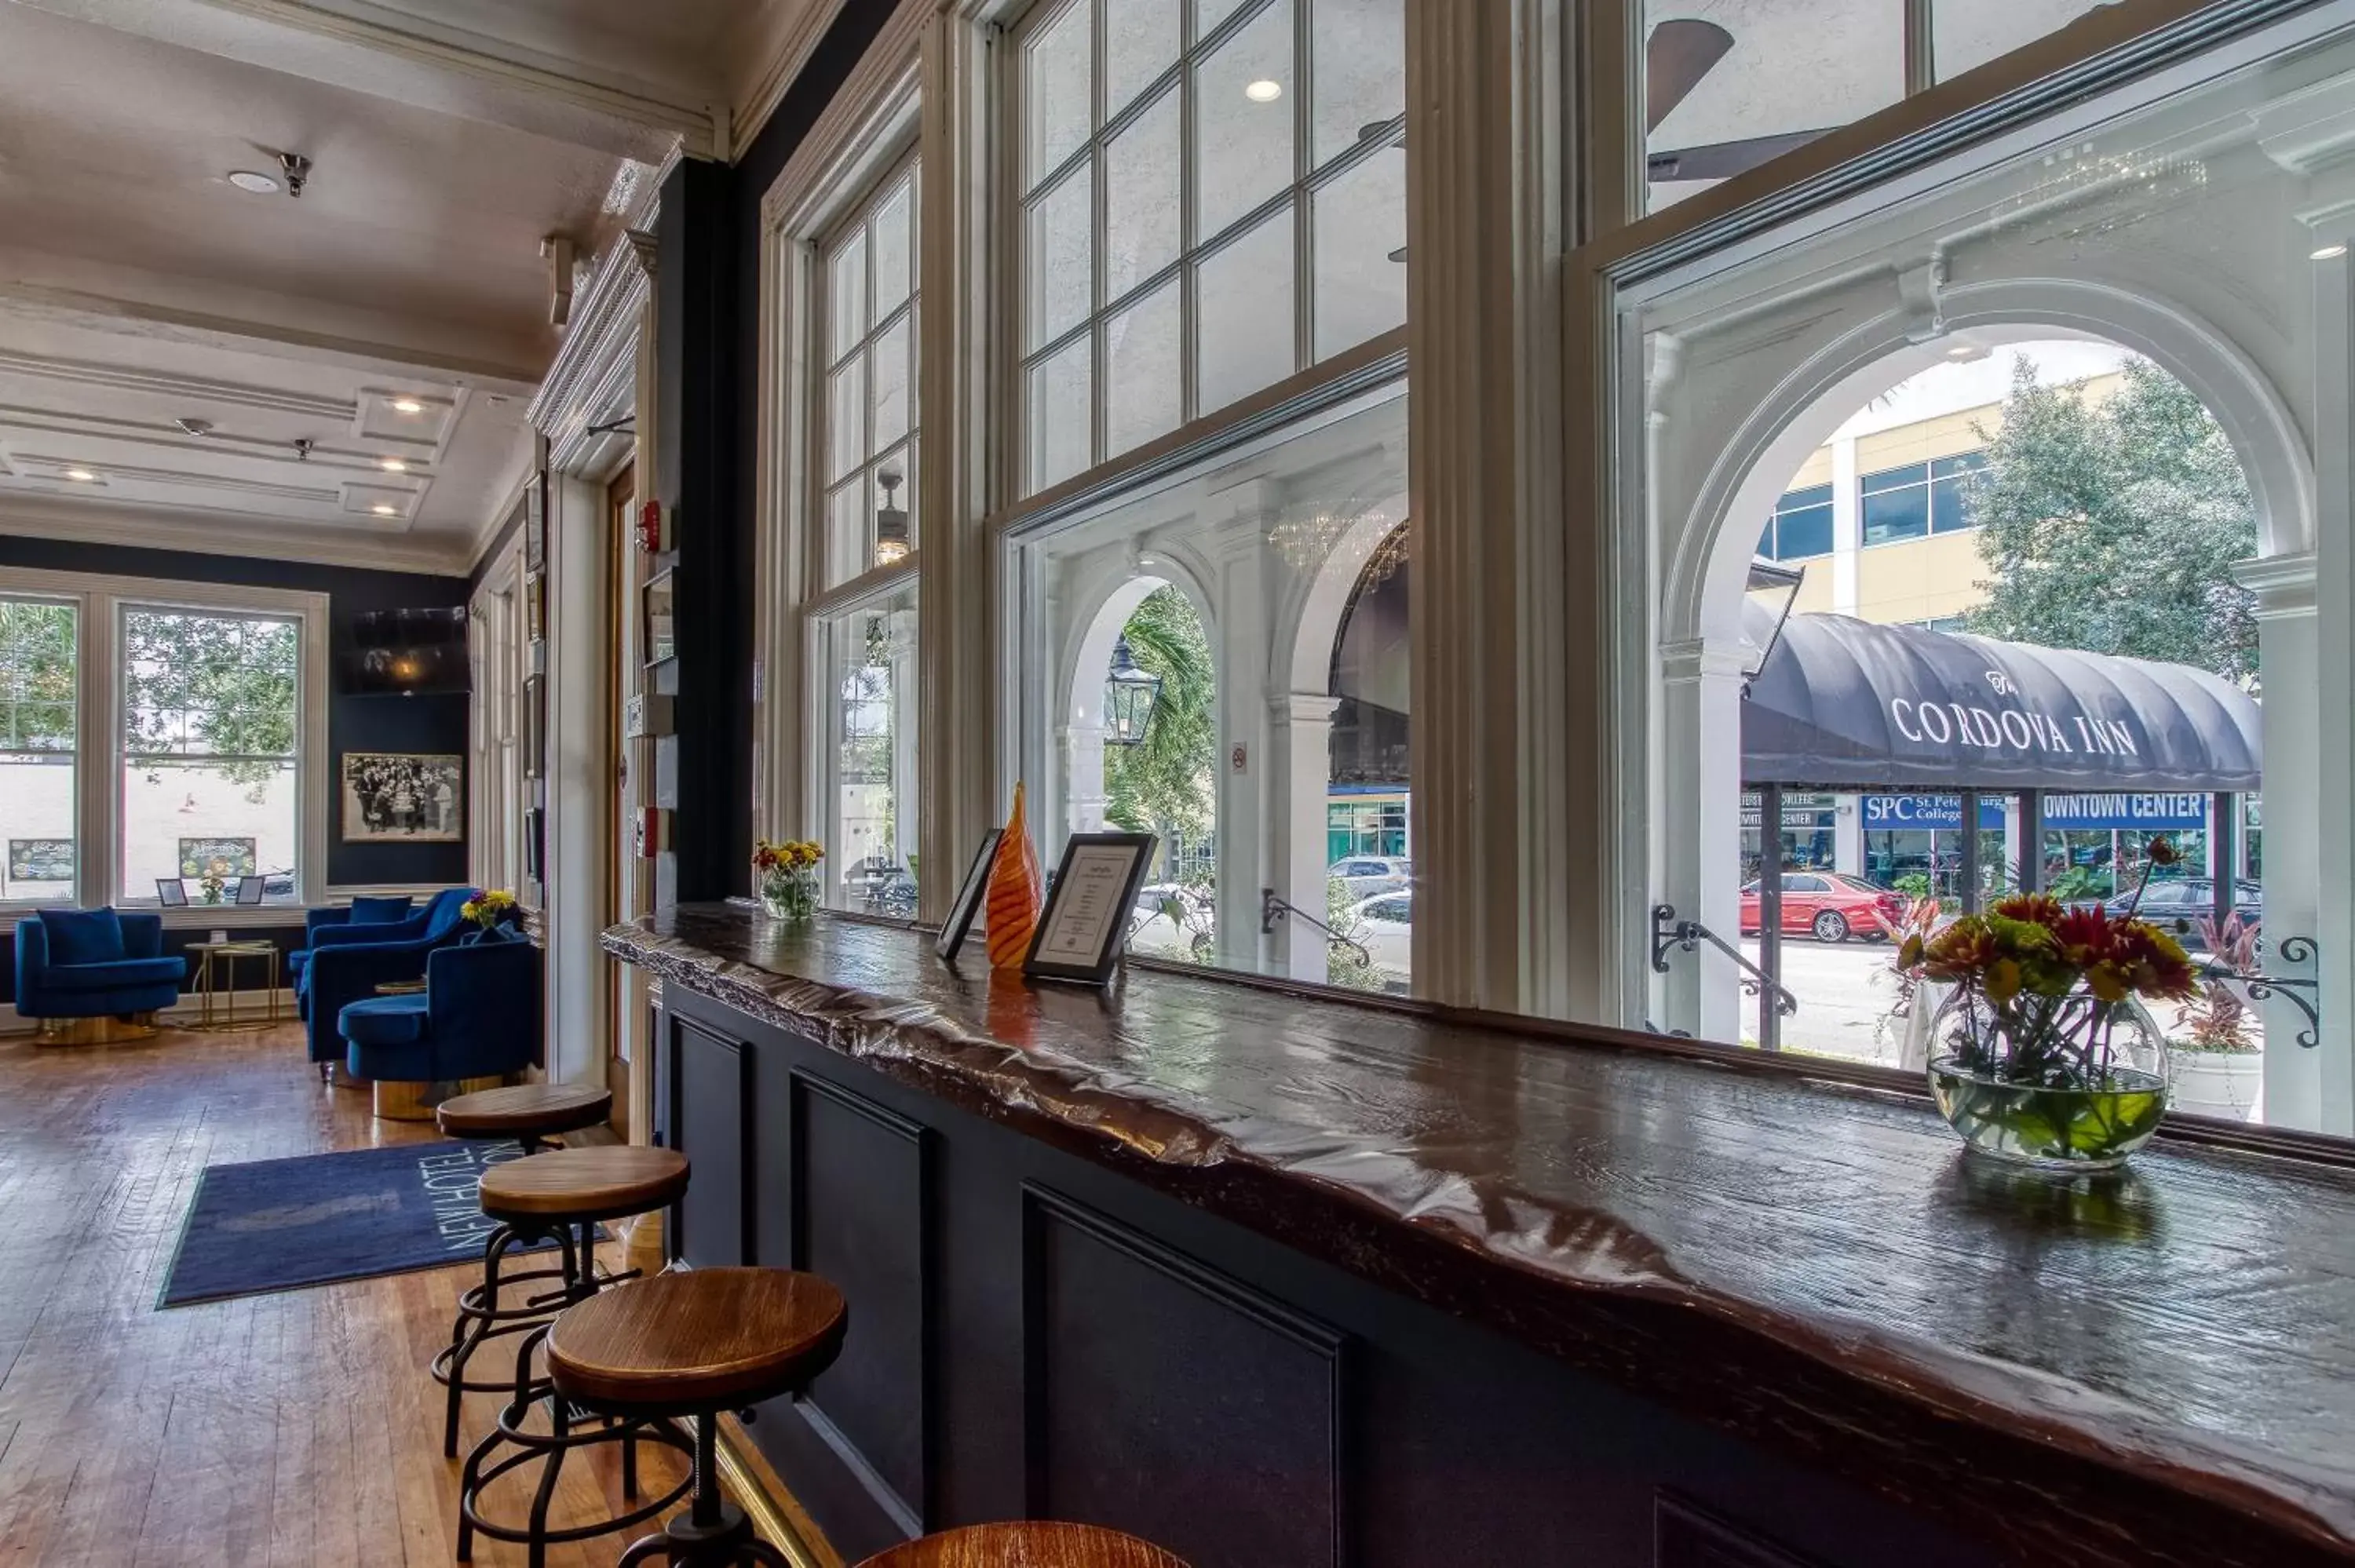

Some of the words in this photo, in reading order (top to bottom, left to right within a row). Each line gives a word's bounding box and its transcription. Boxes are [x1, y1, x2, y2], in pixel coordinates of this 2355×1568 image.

[1891, 698, 2073, 753] CORDOVA
[2072, 715, 2139, 757] INN
[1867, 797, 1913, 820] SPC
[1915, 797, 1931, 808] St.
[1915, 808, 1962, 822] College
[2043, 794, 2127, 818] OWNTOWN
[2131, 793, 2201, 817] CENTER
[417, 1147, 481, 1202] HOTEL
